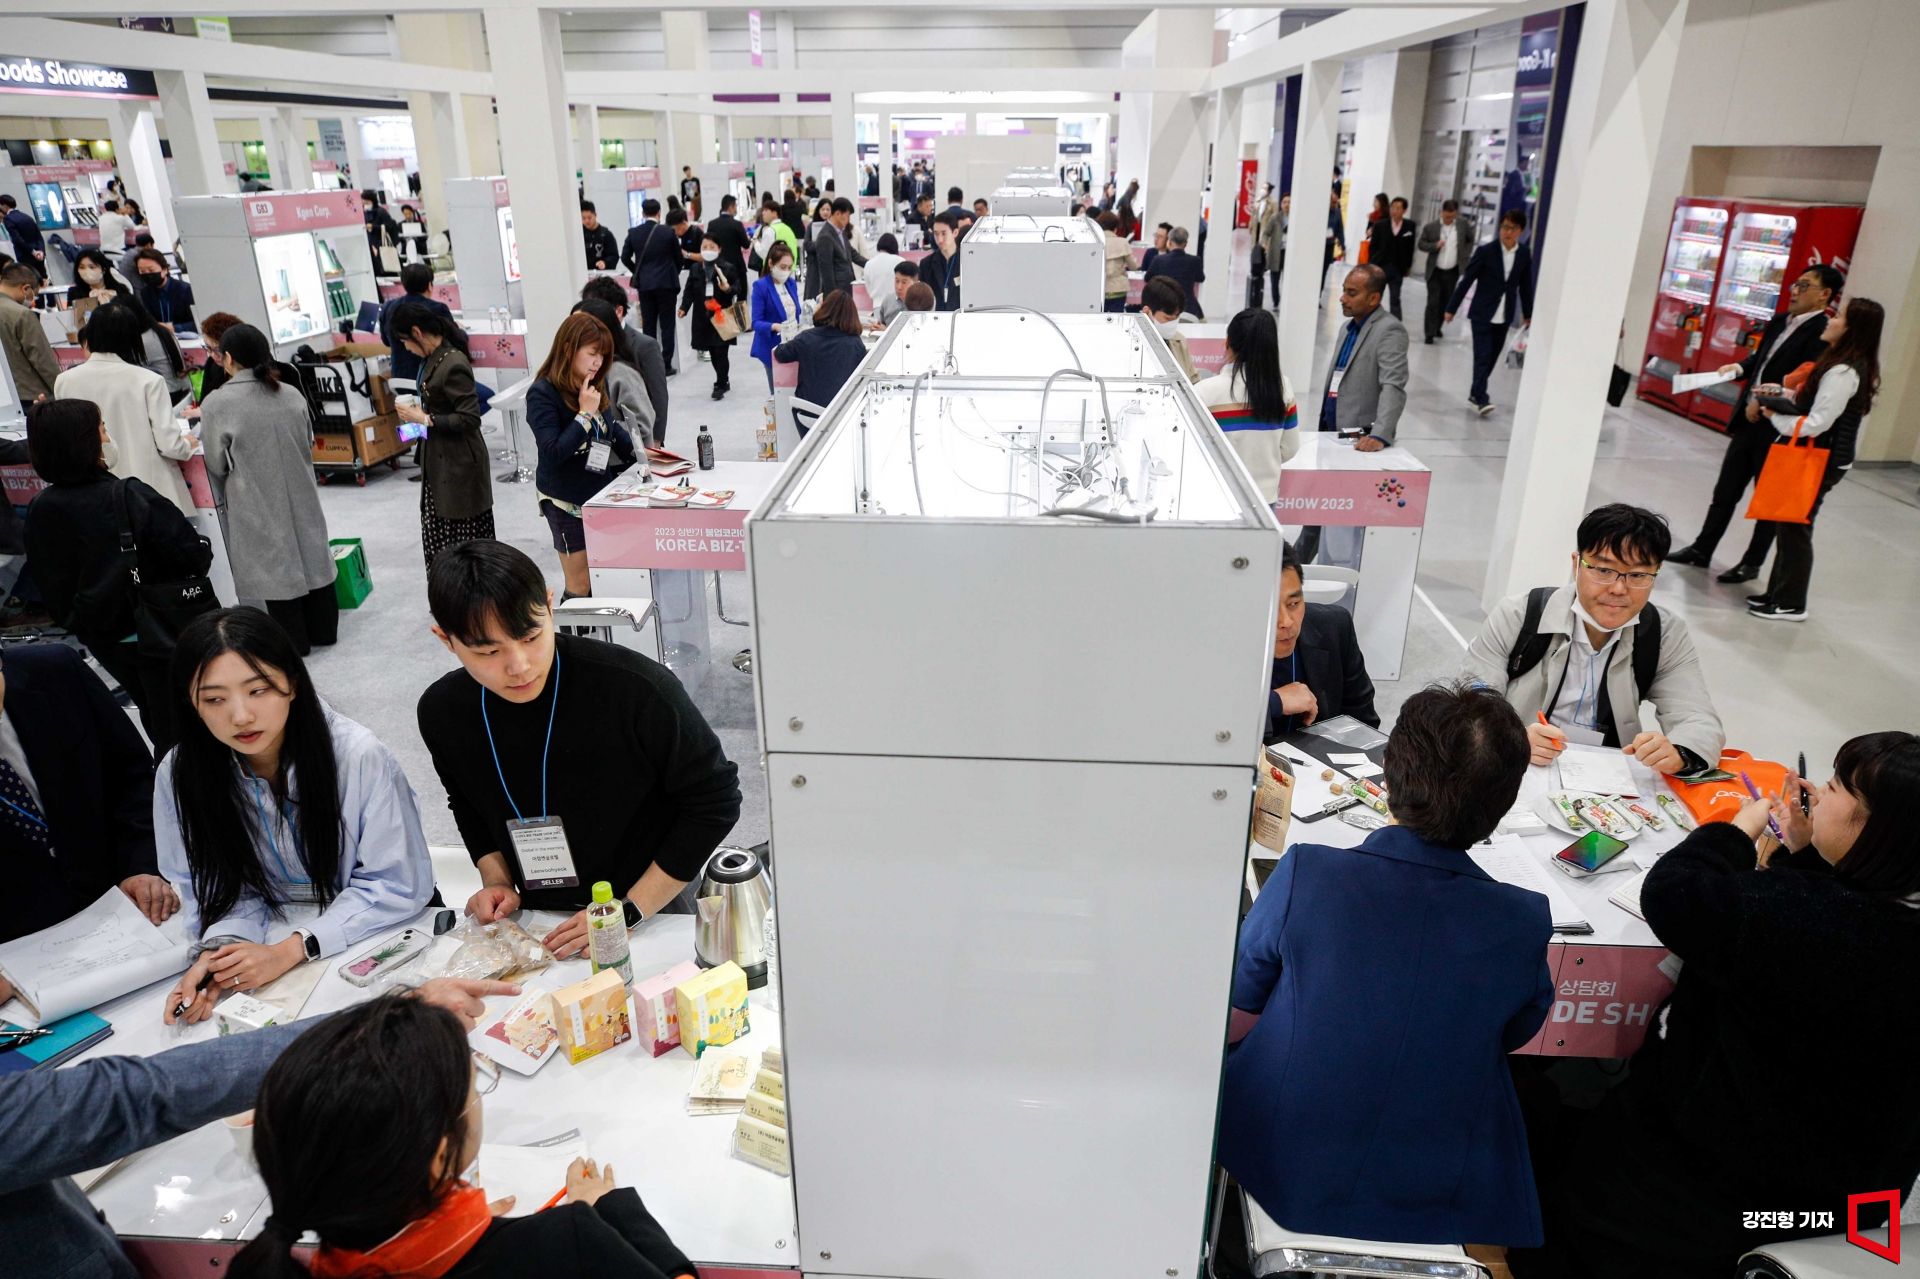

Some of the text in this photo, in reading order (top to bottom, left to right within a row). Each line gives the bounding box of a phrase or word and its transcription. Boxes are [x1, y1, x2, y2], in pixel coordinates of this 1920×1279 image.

[45, 61, 128, 89] Showcase
[314, 205, 332, 219] Corp.
[1276, 498, 1354, 510] SHOW 2023
[654, 527, 676, 536] 2023
[678, 527, 703, 537] 상반기
[655, 539, 708, 552] KOREA
[1560, 980, 1616, 997] 상담회
[1601, 1002, 1657, 1026] SH
